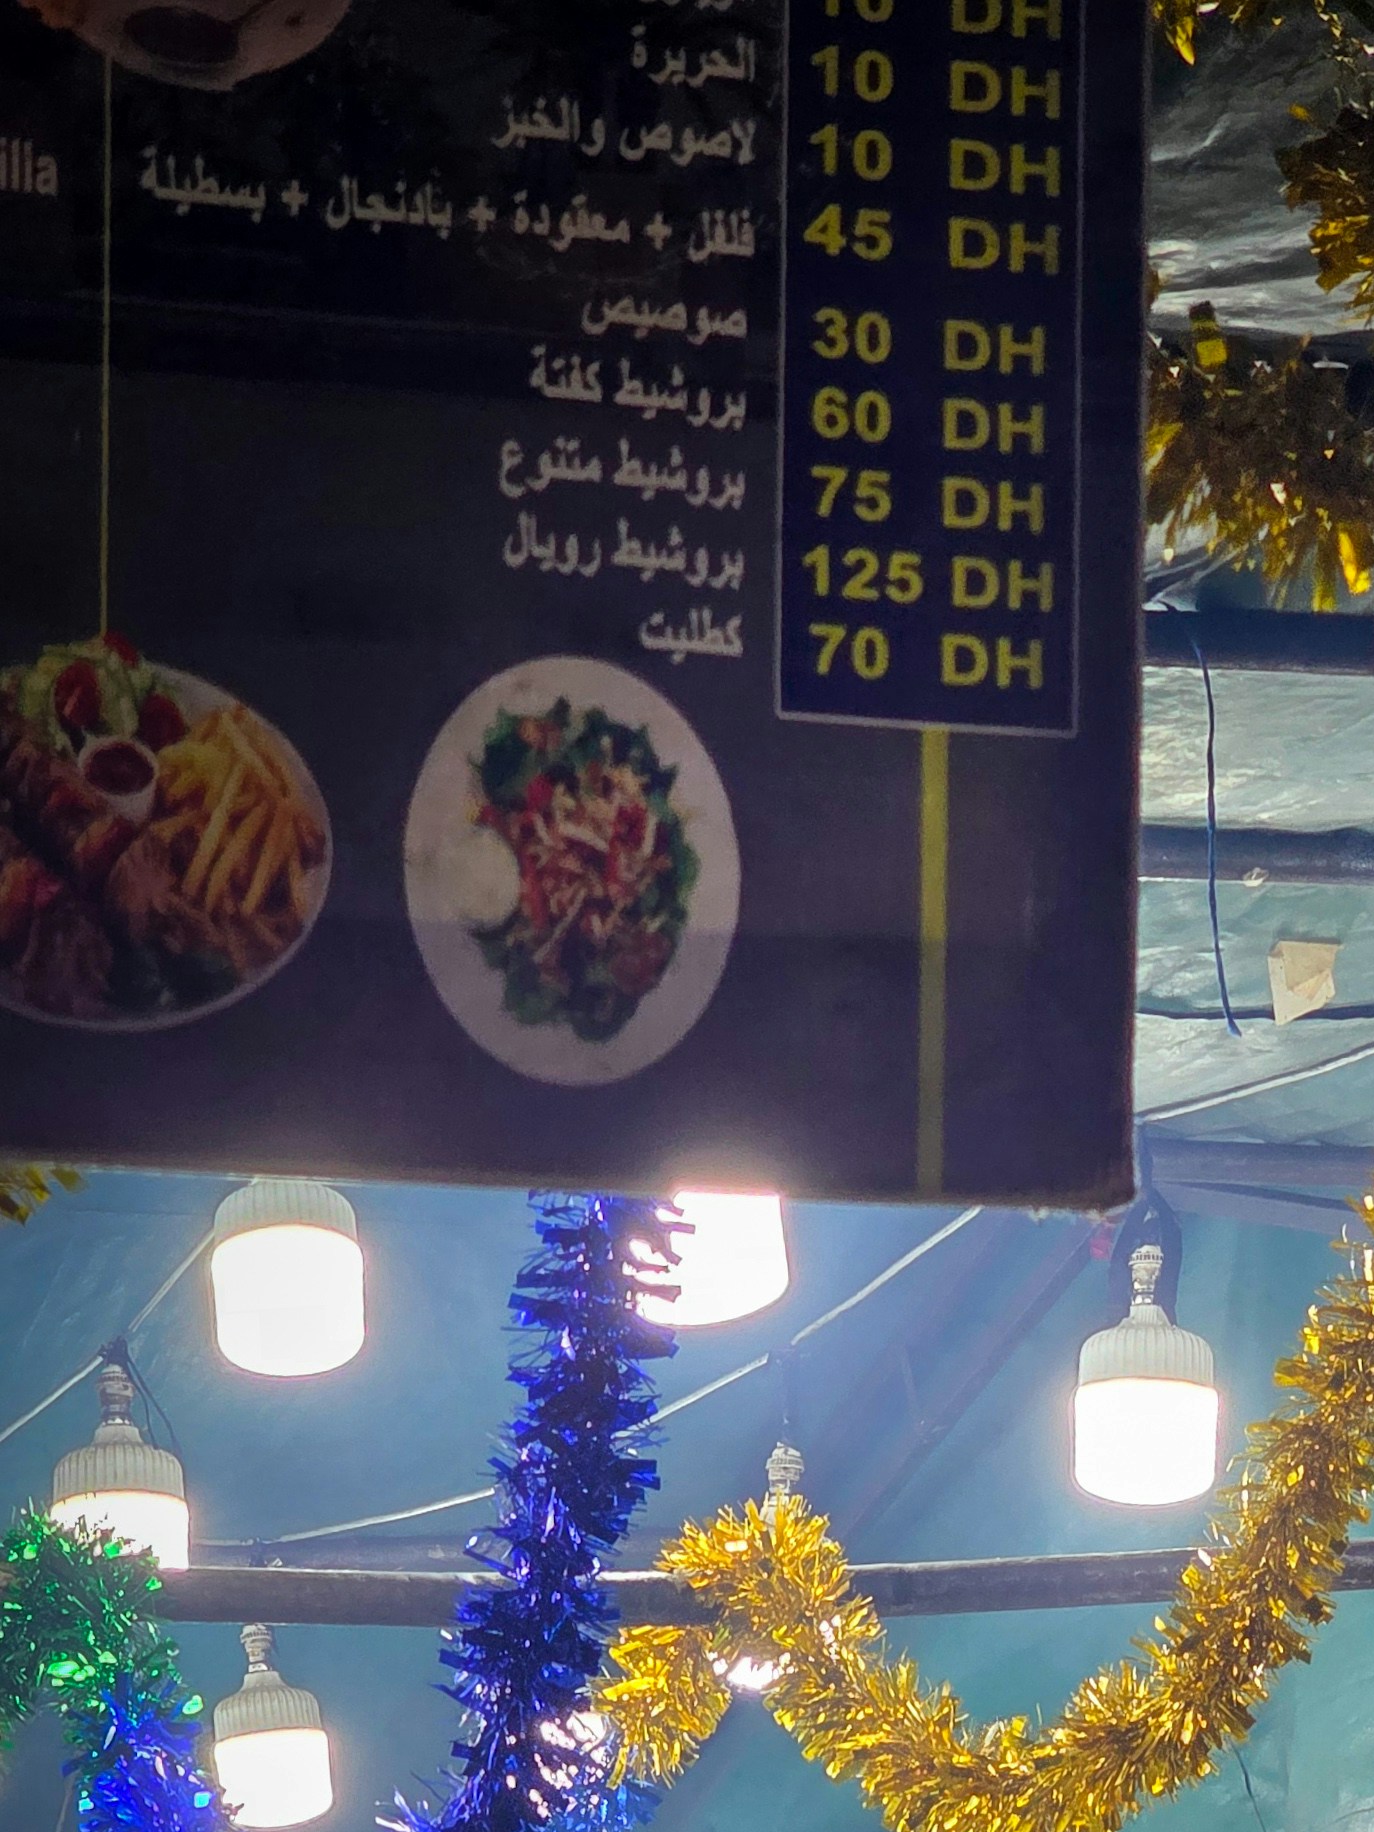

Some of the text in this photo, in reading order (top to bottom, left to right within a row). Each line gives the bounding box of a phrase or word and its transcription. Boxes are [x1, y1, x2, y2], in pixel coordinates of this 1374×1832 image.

[952, 0, 1062, 41] DH
[632, 24, 756, 88] الحريرة
[811, 44, 1062, 120] 10 DH
[490, 96, 606, 157] والخبز
[808, 123, 1061, 198] 10 DH
[140, 145, 267, 224] بسطيلة
[281, 179, 309, 216] +
[466, 196, 497, 234] +
[512, 188, 632, 253] معقودة
[643, 212, 674, 251] +
[686, 208, 757, 264] فلفل
[802, 203, 1060, 276] 45 DH
[582, 295, 746, 347] صوصيص
[812, 307, 1046, 375] 30 DH
[528, 343, 747, 430] بروشيط كفتة
[811, 386, 1045, 454] 60 DH
[611, 436, 747, 511] بروشيط
[810, 465, 1045, 533] 75 DH
[502, 510, 746, 592] بروشيط رويال
[802, 544, 1055, 613] 125 DH
[639, 605, 745, 665] كطليت
[809, 622, 1043, 690] 70 DH
